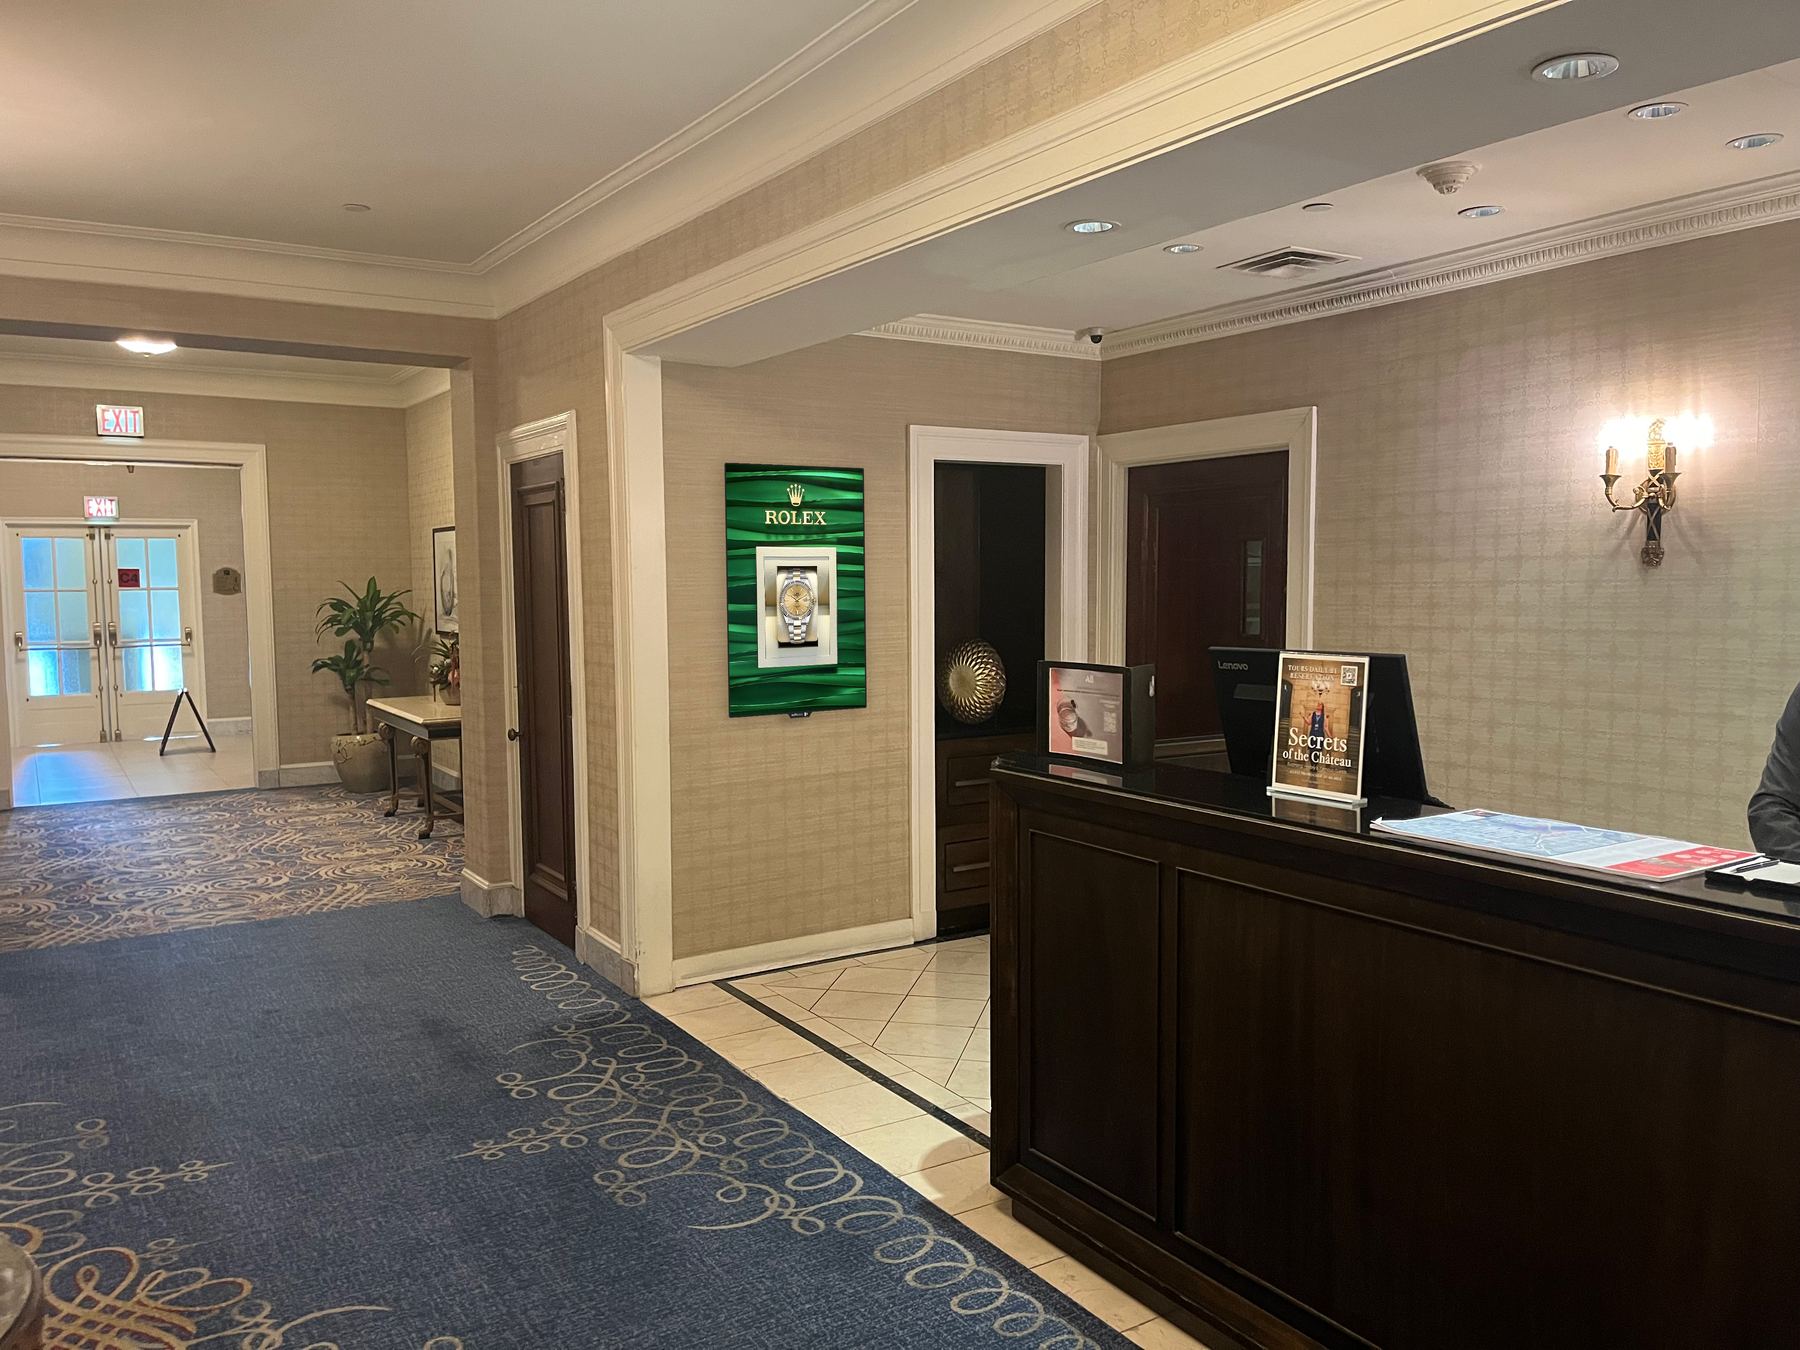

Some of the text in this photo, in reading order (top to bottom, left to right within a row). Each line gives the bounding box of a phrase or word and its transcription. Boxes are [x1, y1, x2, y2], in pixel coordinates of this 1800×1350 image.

[101, 408, 139, 433] EXIT
[86, 498, 115, 517] EXIT
[764, 510, 827, 525] ROLEX
[1217, 660, 1249, 671] Lenovo
[1287, 664, 1309, 672] TOURS
[1288, 727, 1348, 753] Secrets
[1282, 748, 1294, 760] of
[1294, 748, 1310, 762] the
[1311, 750, 1352, 768] Château
